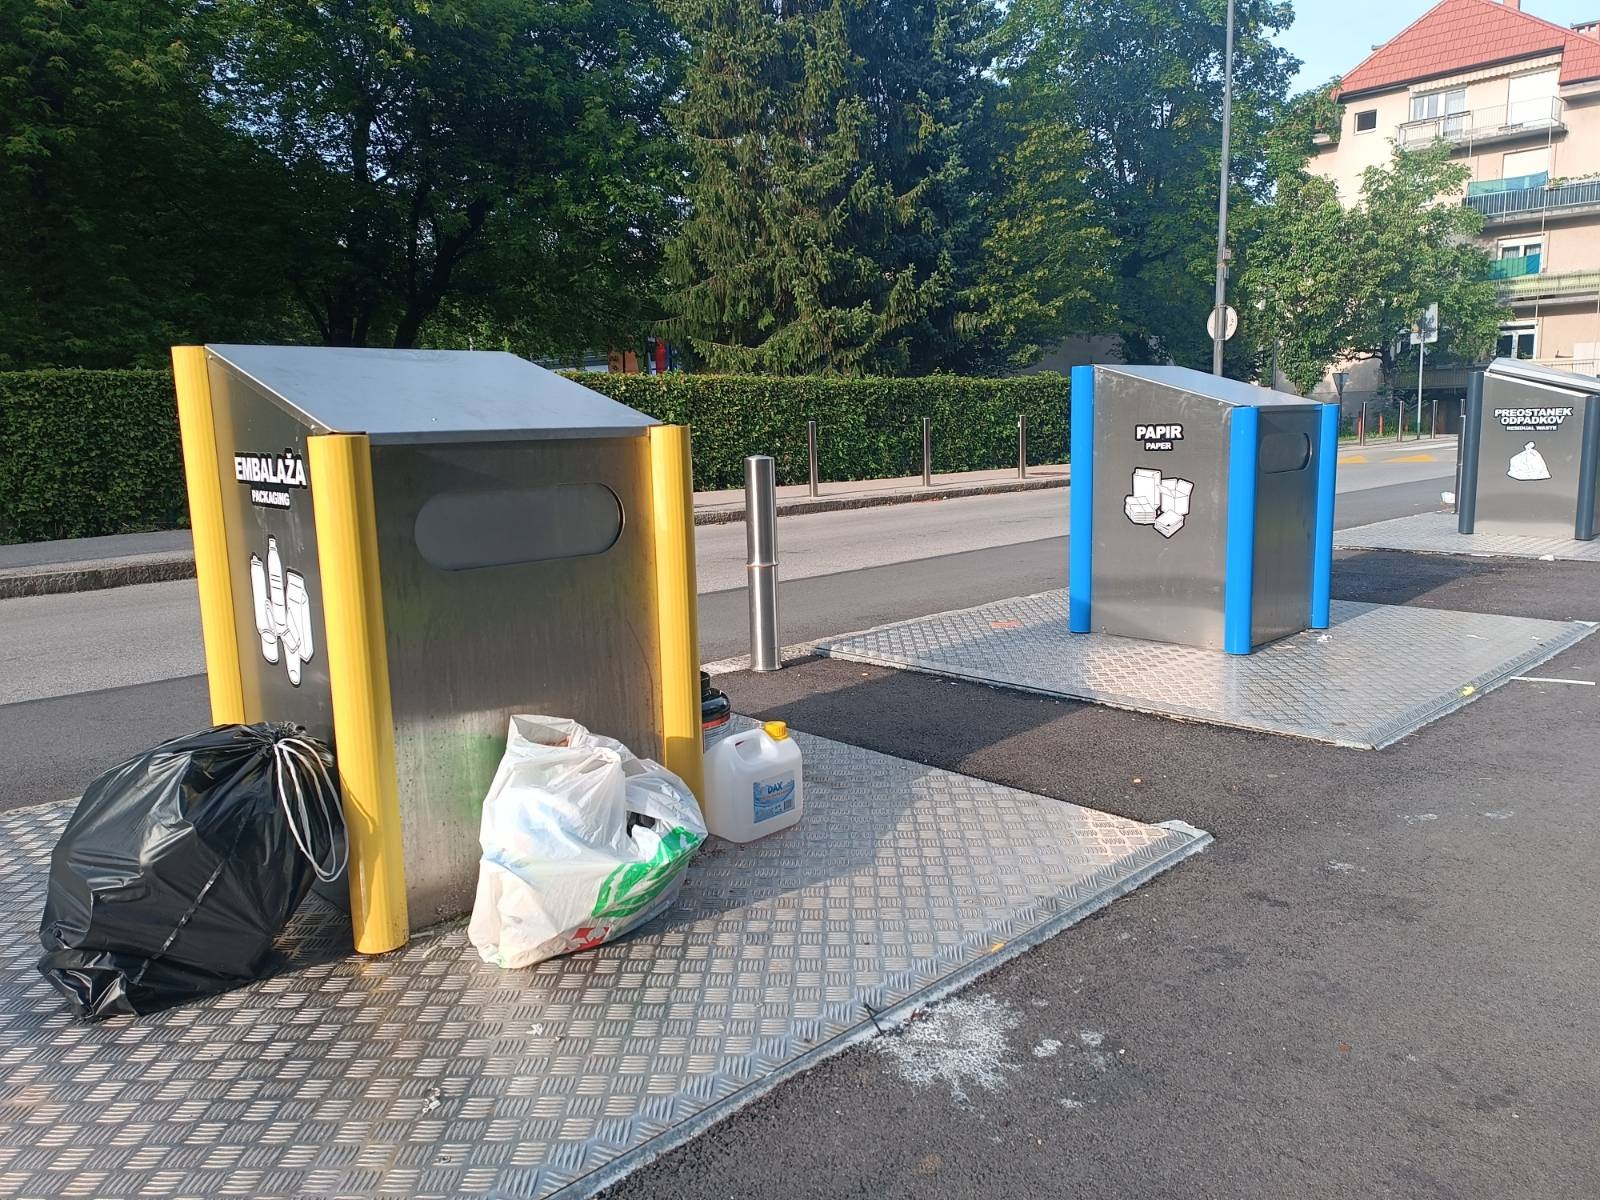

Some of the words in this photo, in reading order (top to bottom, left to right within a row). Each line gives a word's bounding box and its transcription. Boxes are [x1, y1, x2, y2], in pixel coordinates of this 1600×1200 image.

[1494, 408, 1572, 417] PREOSTANEK
[1501, 416, 1565, 425] ODPADKOV
[1136, 426, 1182, 439] PAPIR
[1145, 442, 1172, 450] PAPER
[234, 453, 307, 486] EMBALAŽA
[251, 490, 290, 506] PACKAGING
[767, 781, 784, 794] DAX
